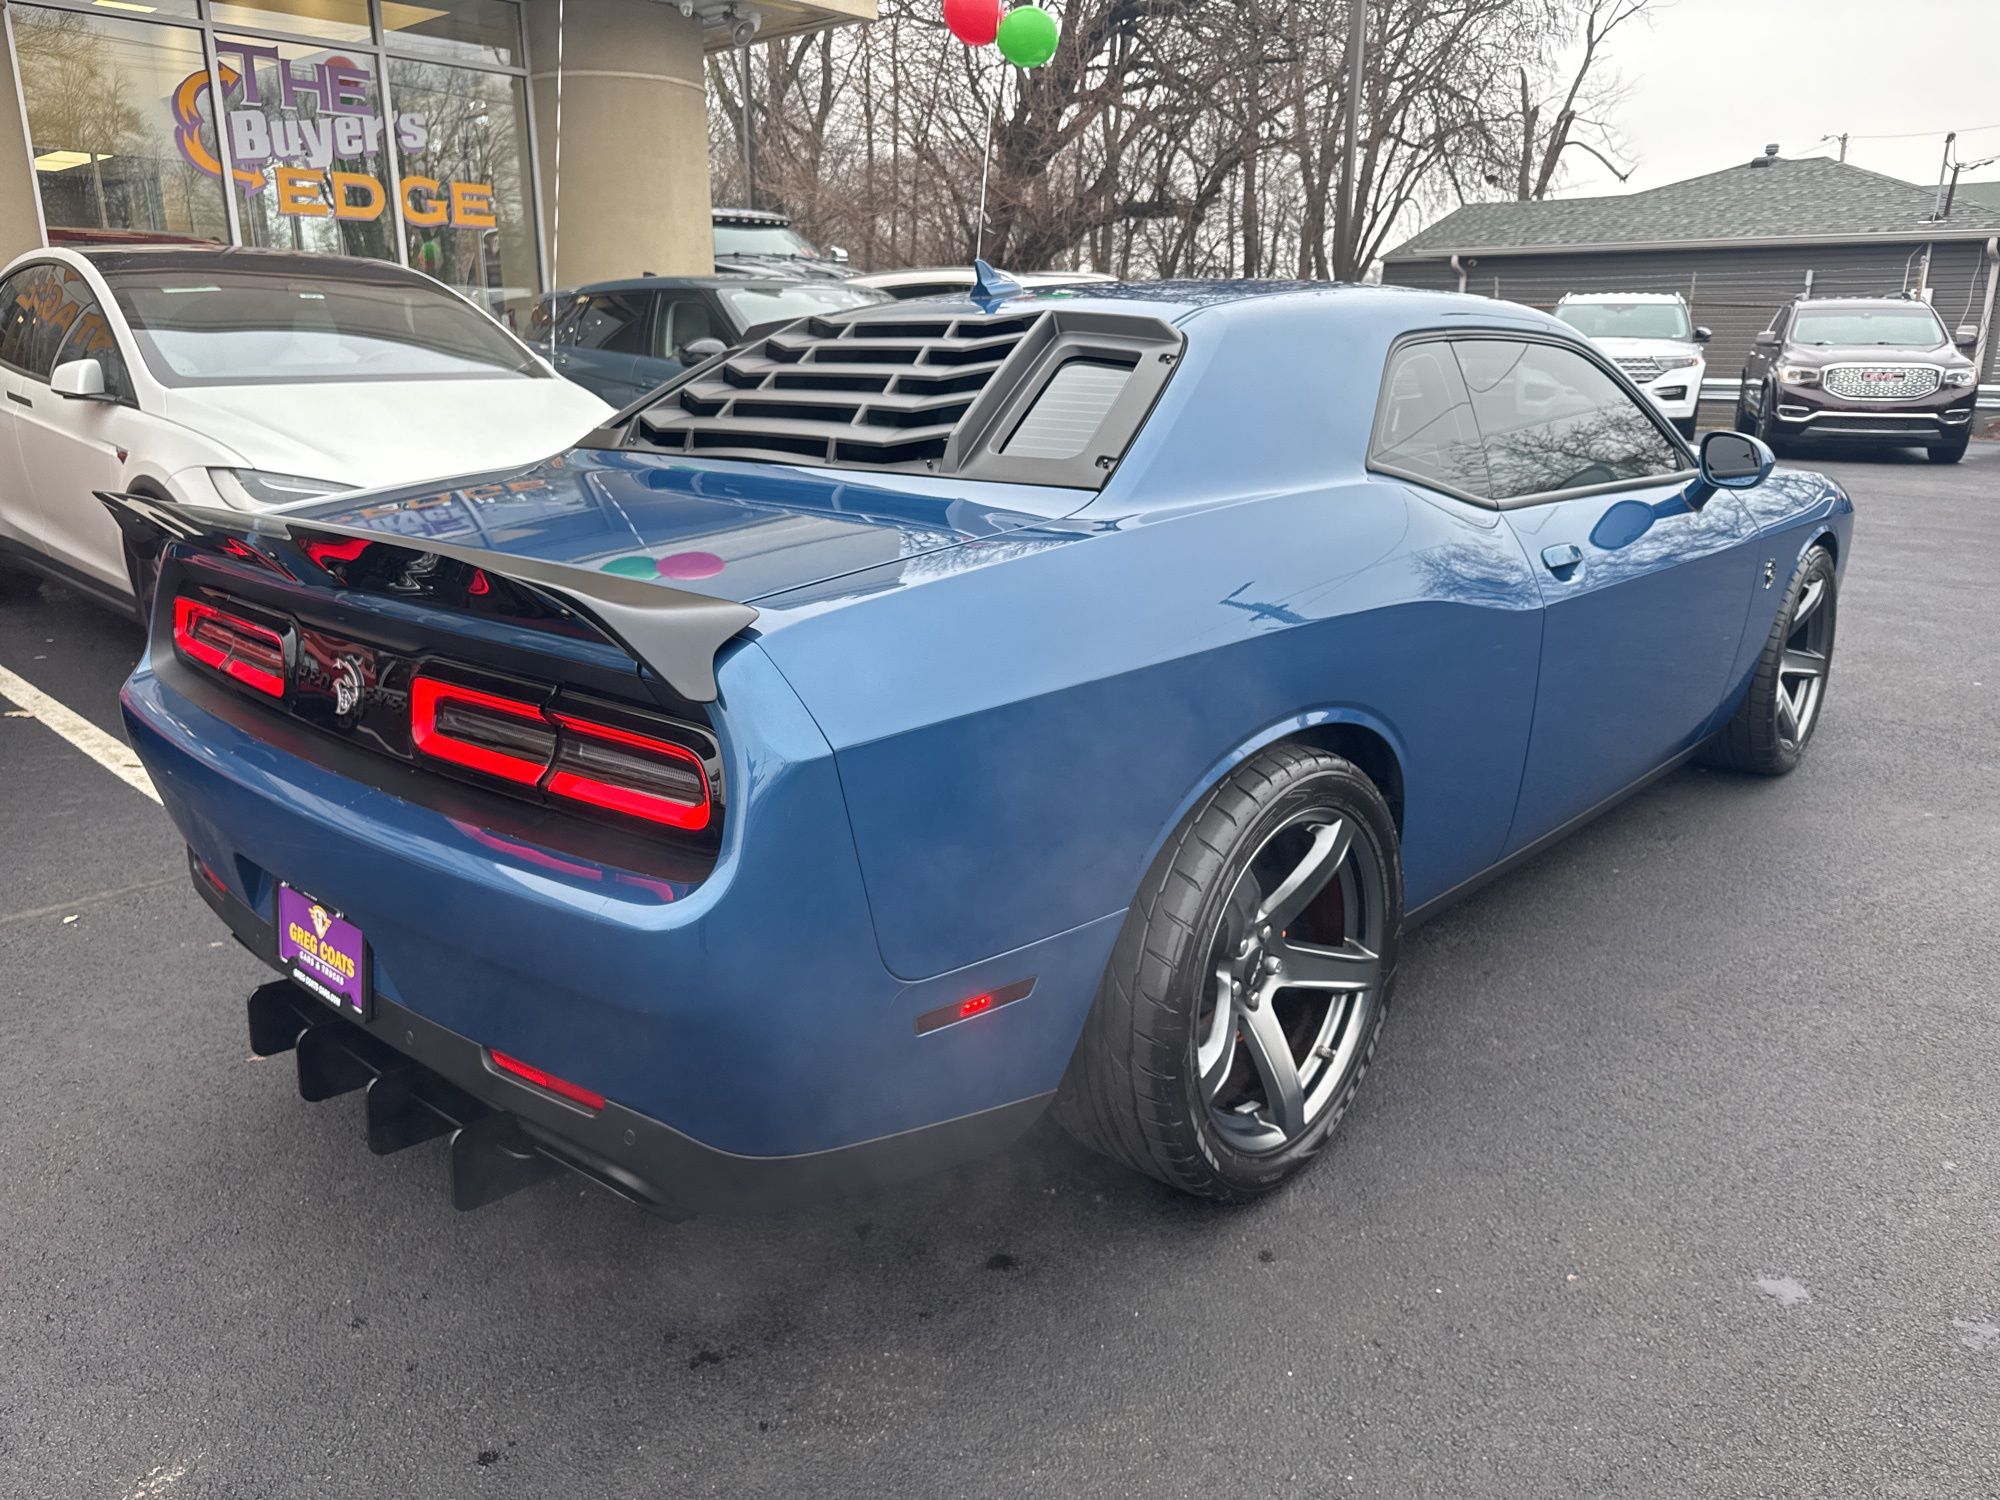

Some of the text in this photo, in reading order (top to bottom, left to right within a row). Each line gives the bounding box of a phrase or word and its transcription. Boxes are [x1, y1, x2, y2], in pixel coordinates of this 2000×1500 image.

[215, 37, 375, 117] THE
[227, 109, 429, 170] Buyer's
[274, 166, 497, 229] EDGE
[1861, 372, 1906, 382] GMC
[289, 922, 355, 978] GREG COATS
[299, 950, 315, 967] CARS
[321, 965, 344, 986] TRUCKS
